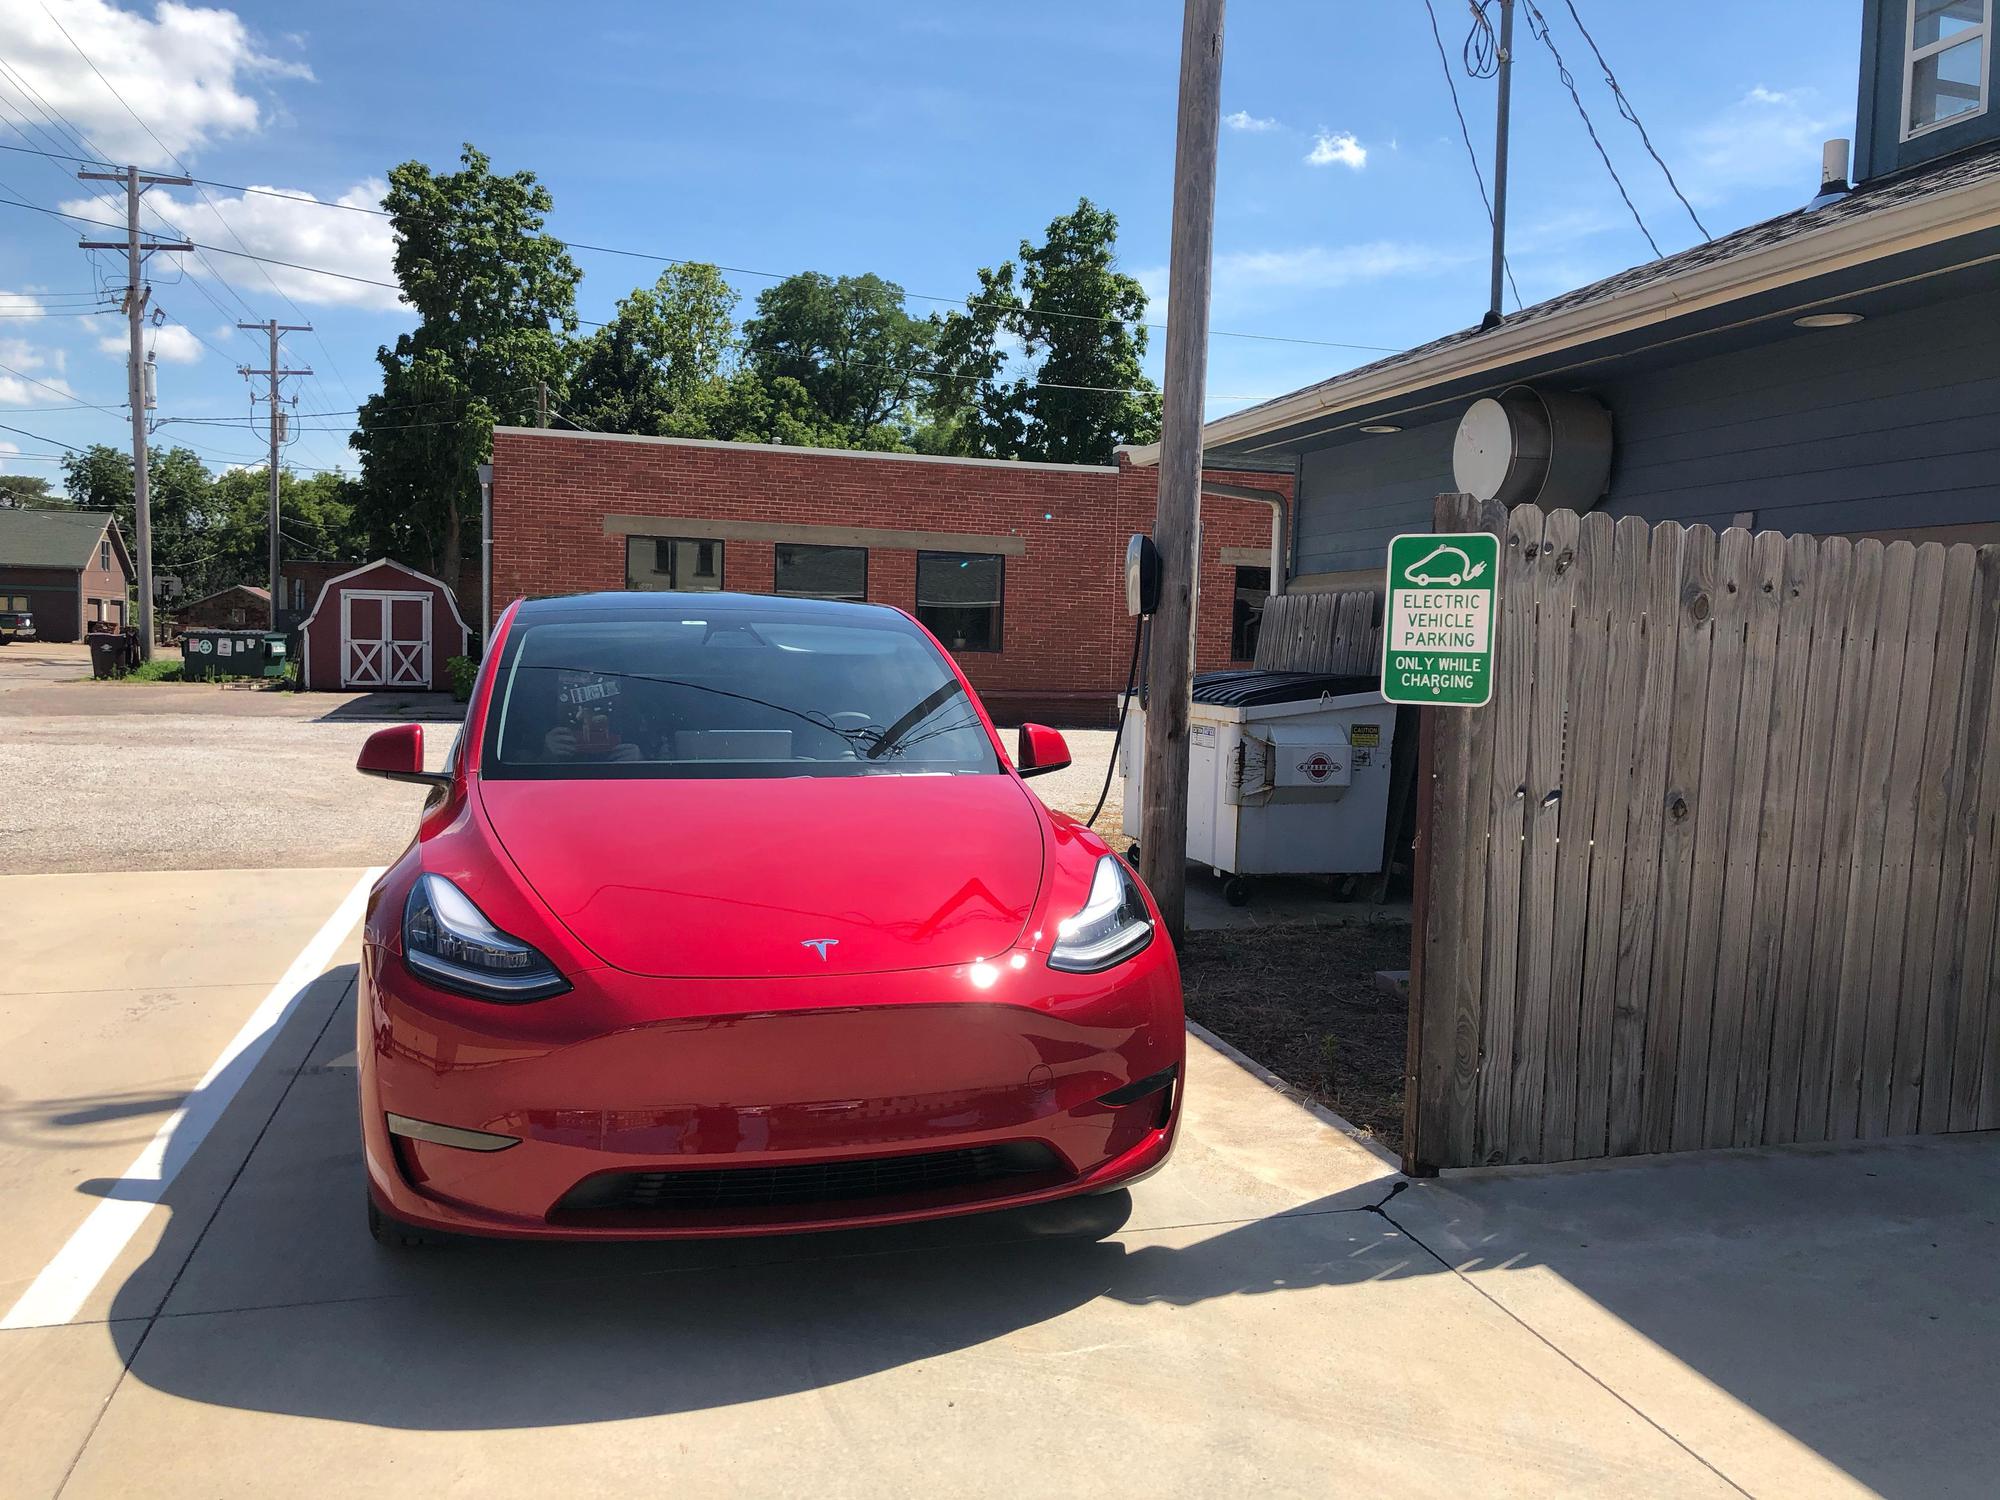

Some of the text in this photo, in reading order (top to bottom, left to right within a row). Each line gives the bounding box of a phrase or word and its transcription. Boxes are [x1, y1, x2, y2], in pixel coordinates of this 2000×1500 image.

[1403, 594, 1480, 609] ELECTRIC
[1408, 613, 1474, 628] VEHICLE
[1405, 632, 1475, 647] PARKING
[1395, 656, 1481, 672] ONLY WHILE
[1401, 673, 1474, 689] CHARGING
